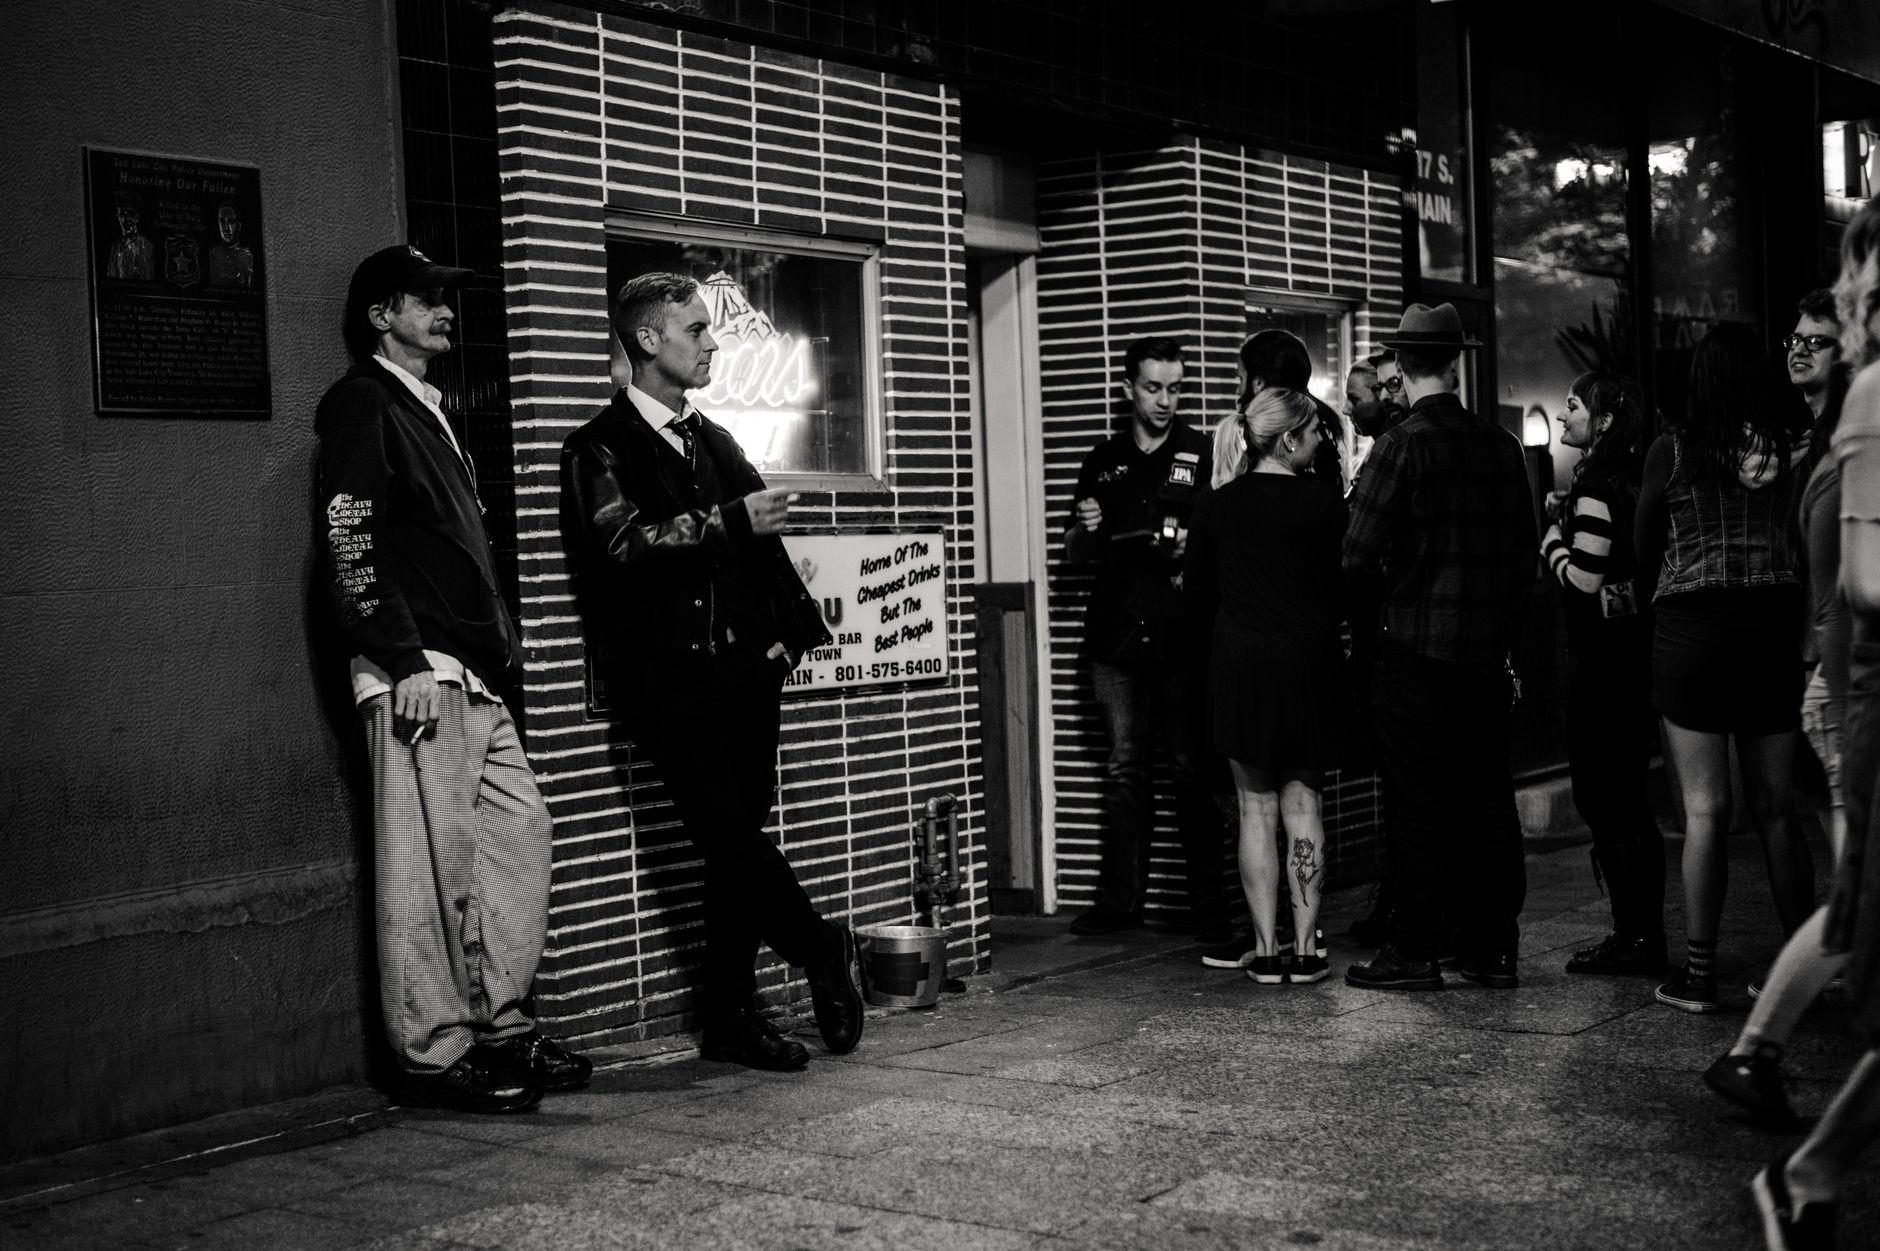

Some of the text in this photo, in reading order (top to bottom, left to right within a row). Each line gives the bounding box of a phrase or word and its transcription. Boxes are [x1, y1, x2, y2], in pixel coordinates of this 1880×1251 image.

[1416, 149, 1433, 180] 17
[119, 171, 237, 195] Honoring Our Fallen
[860, 541, 929, 577] Home Of The
[857, 563, 941, 605] Cheapest Drinks
[880, 597, 922, 624] But The
[838, 632, 862, 645] BAR
[874, 617, 934, 653] Best People
[806, 648, 842, 661] TOWN
[783, 669, 813, 686] AIN
[835, 658, 942, 681] 801-575-6400
